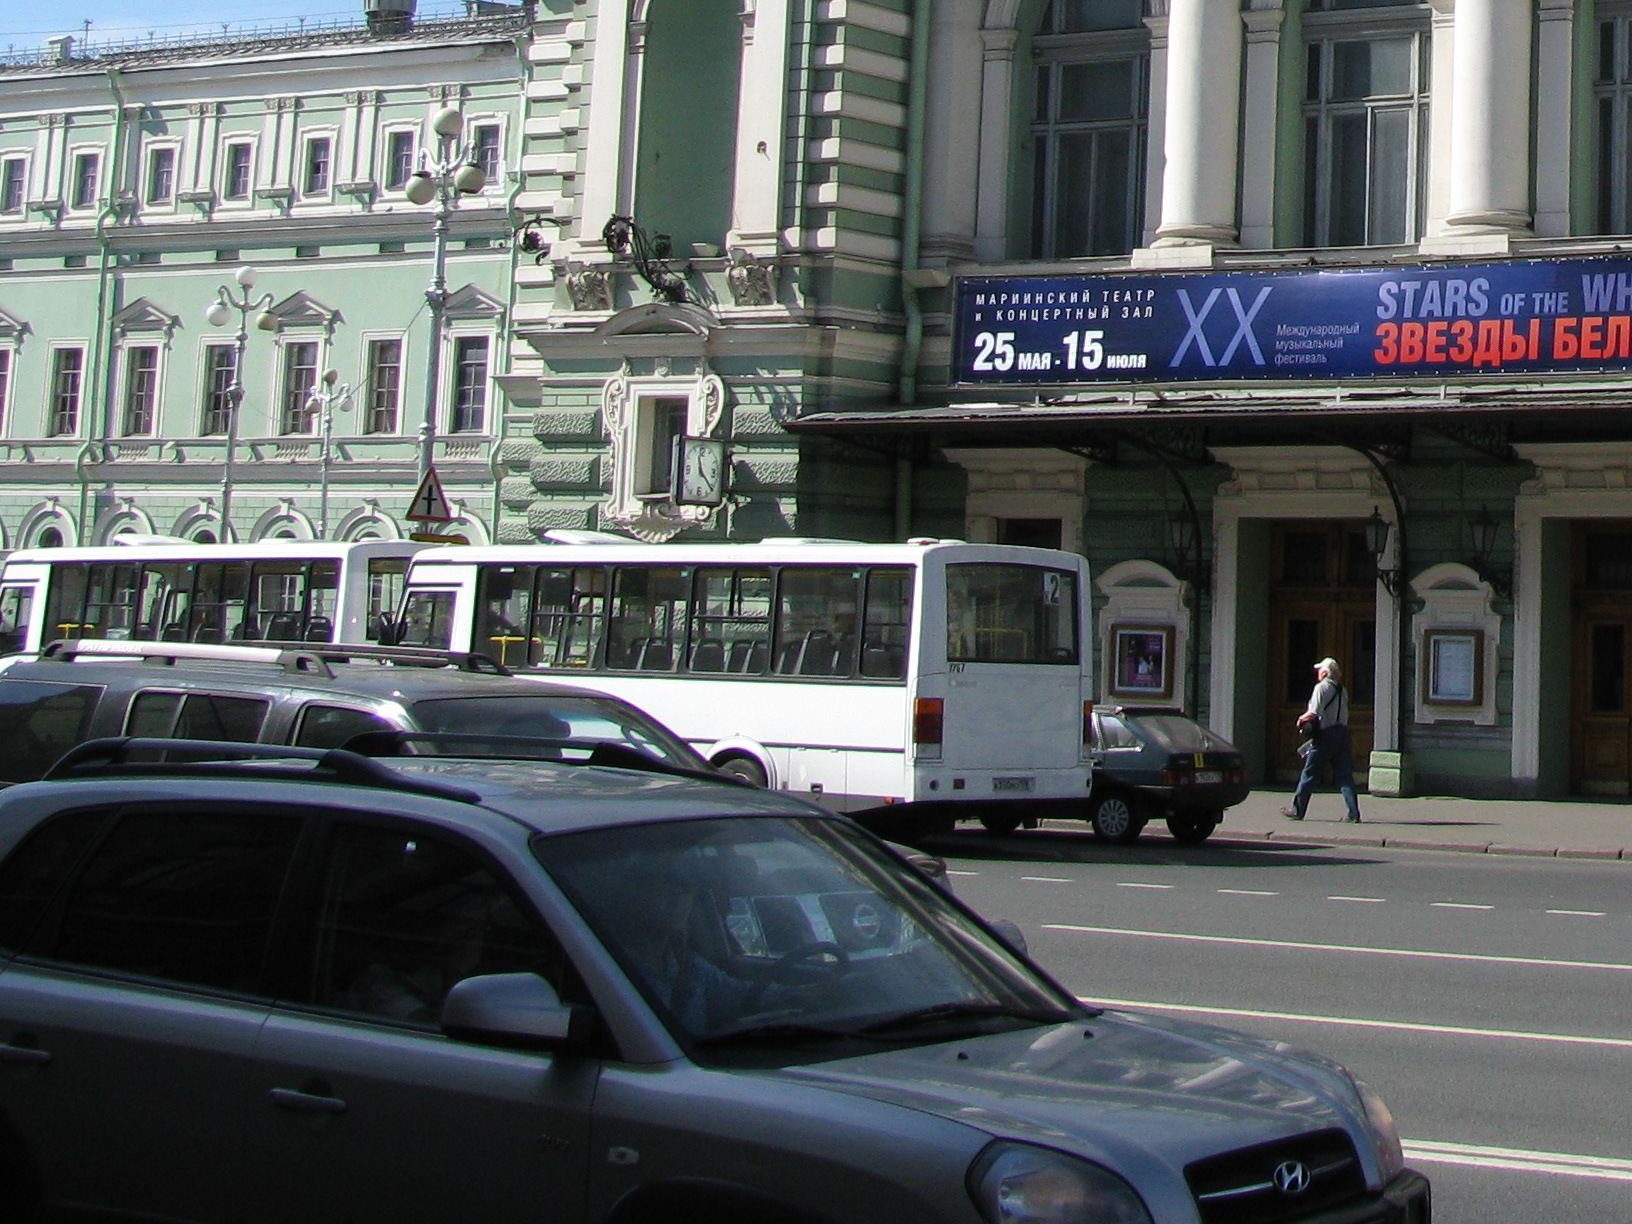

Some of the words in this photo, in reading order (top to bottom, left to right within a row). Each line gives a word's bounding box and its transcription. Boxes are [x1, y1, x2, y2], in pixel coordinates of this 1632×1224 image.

[975, 289, 1091, 305] МАРИИНСКИЙ
[1102, 290, 1155, 303] ТЕАТР
[1377, 277, 1490, 320] STARS
[1500, 293, 1526, 316] OF
[1532, 291, 1569, 314] THE
[996, 305, 1110, 322] КОНЦЕРТНЫЙ
[1121, 306, 1153, 319] ЗАЛ
[1276, 323, 1360, 338] Международный
[972, 331, 1015, 371] 25
[1018, 352, 1051, 370] МАЯ
[1063, 330, 1104, 370] 15
[1106, 354, 1147, 369] ИЮЛЯ
[1275, 337, 1344, 352] музыкальный
[1373, 317, 1540, 367] ЗВЕЗДЫ
[1274, 351, 1328, 367] фестиваль
[1050, 575, 1059, 604] 2
